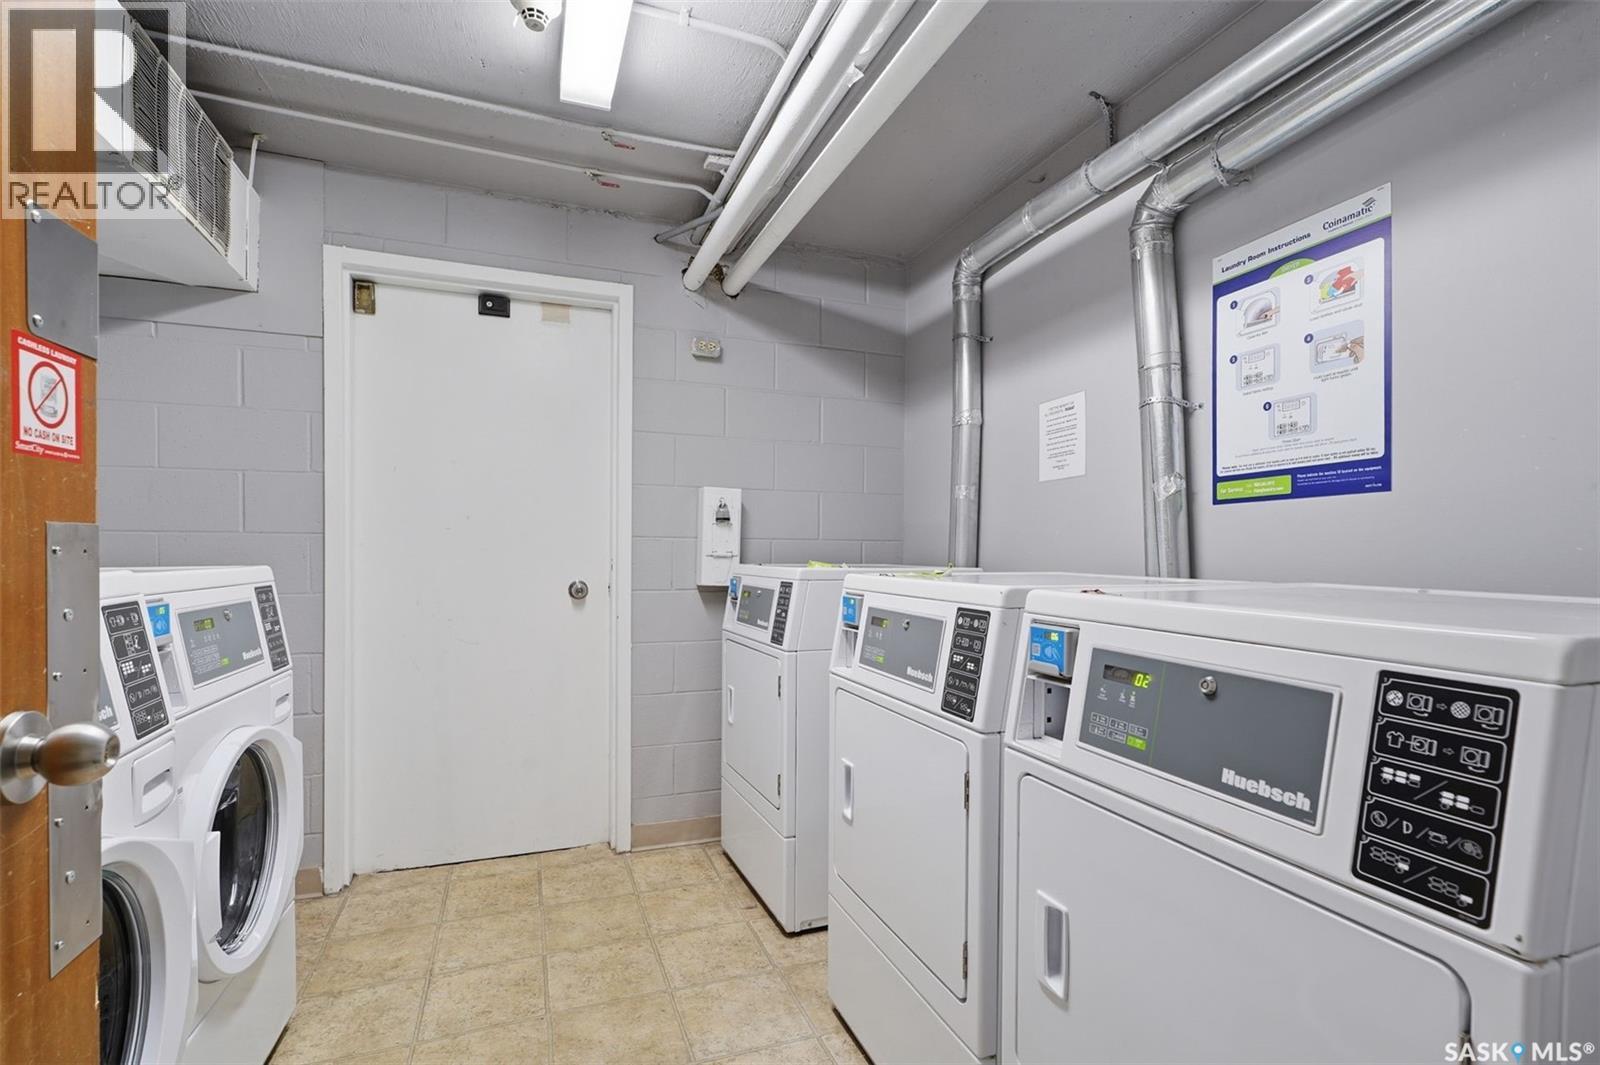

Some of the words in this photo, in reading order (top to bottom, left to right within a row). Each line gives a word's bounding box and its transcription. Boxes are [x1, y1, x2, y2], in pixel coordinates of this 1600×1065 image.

[1322, 204, 1374, 231] Coinamatic
[1221, 258, 1248, 273] Laundry
[1247, 250, 1267, 263] Room
[1267, 232, 1312, 255] Instructions
[23, 426, 33, 437] NO
[34, 428, 51, 441] CASH
[52, 432, 60, 443] ON
[61, 434, 74, 446] SITE
[1134, 672, 1152, 688] 02
[1221, 767, 1311, 812] Huebsch
